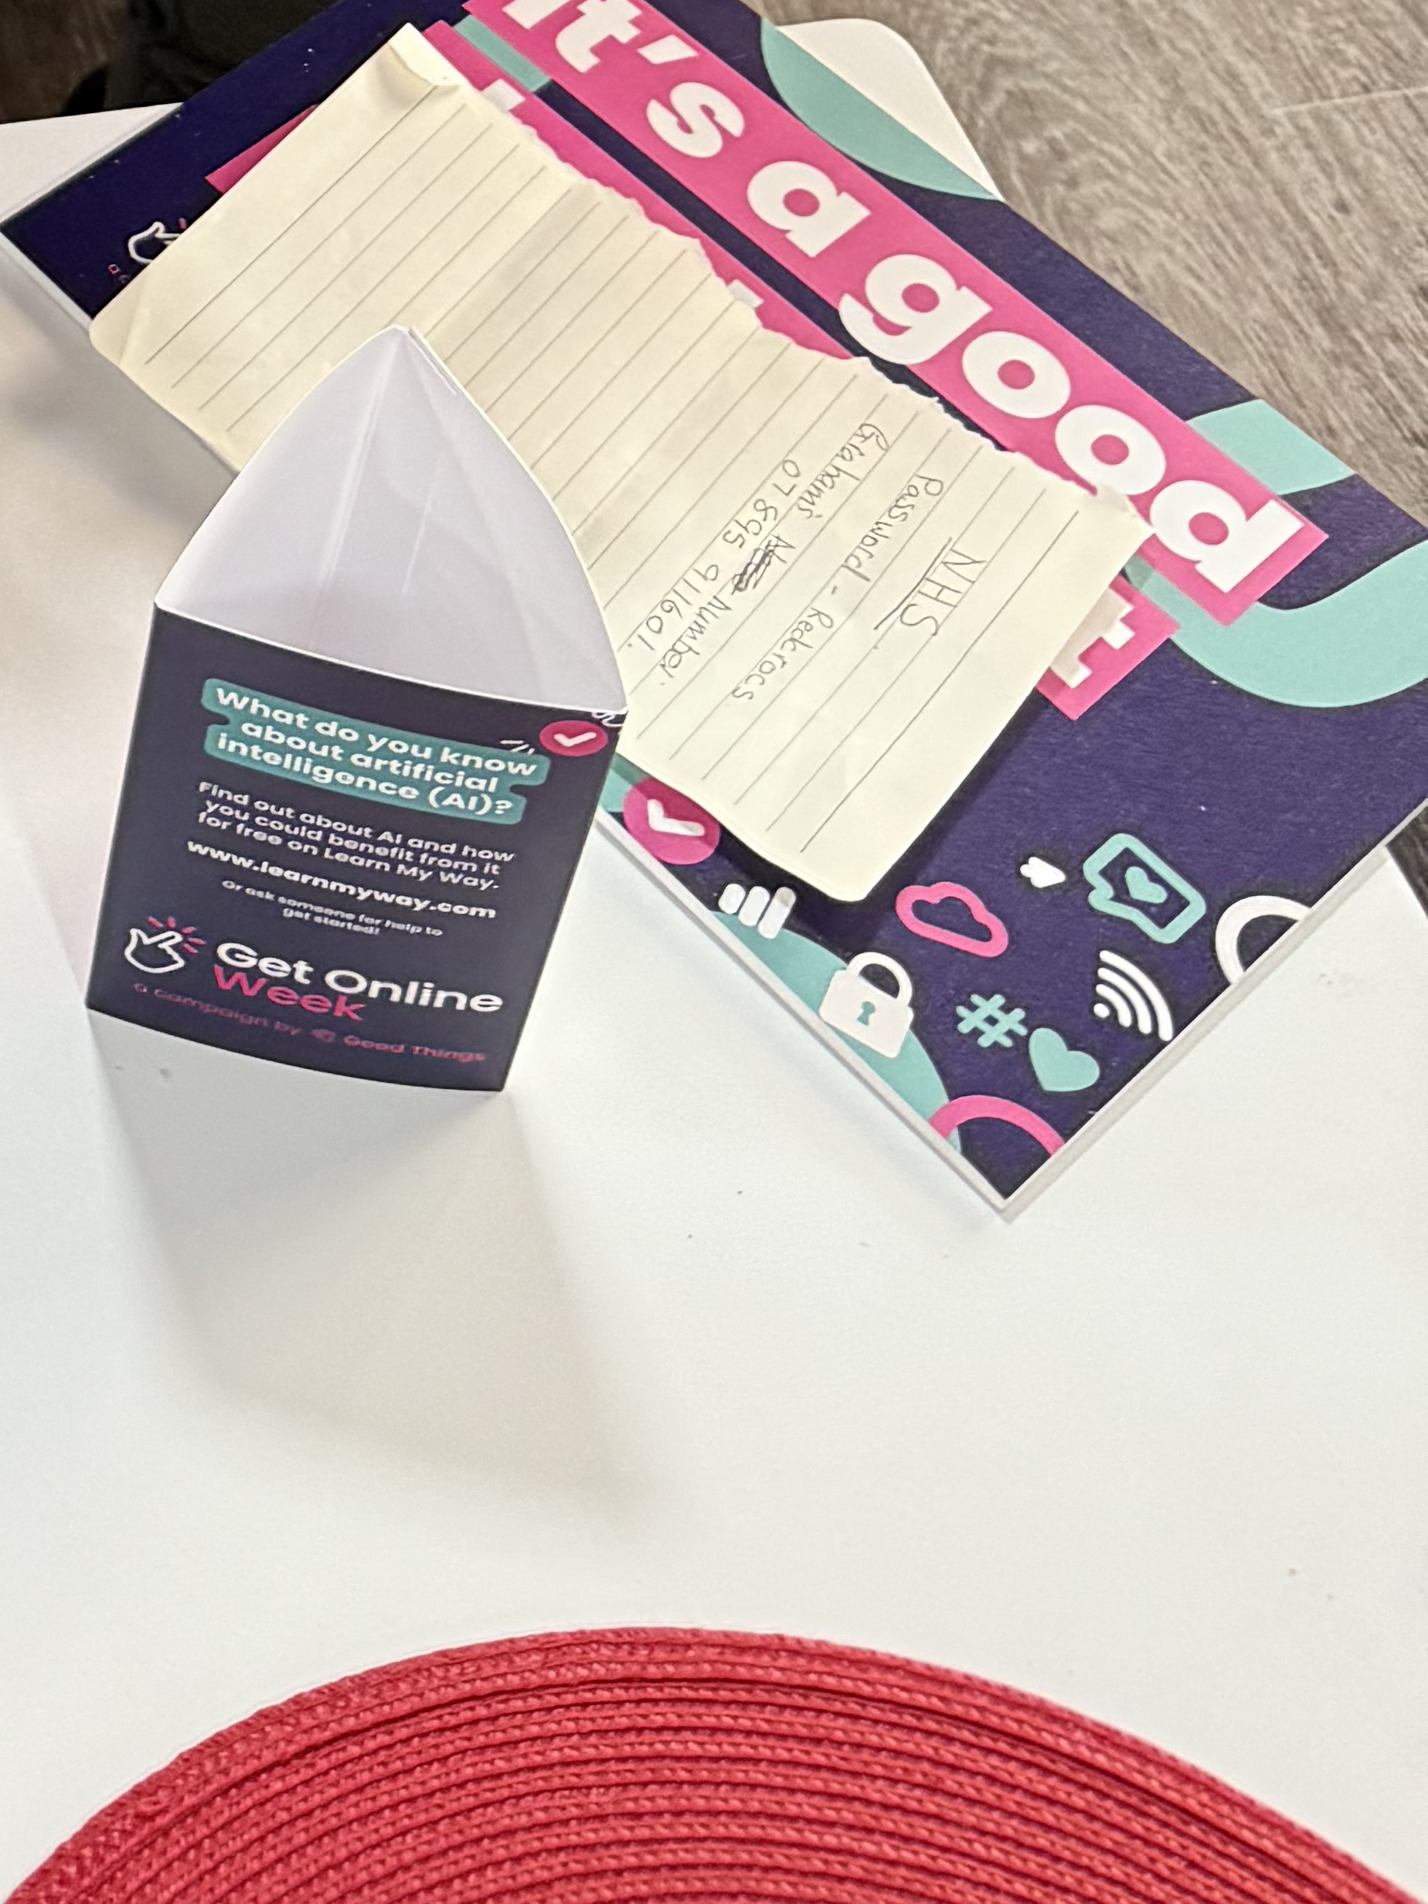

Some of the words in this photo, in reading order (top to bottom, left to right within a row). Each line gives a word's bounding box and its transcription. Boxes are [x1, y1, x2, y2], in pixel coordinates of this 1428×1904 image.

[746, 160, 870, 259] a
[838, 253, 1305, 593] good
[842, 473, 945, 583] Password
[898, 548, 988, 637] NHS
[216, 687, 309, 730] What
[314, 721, 359, 742] do
[367, 733, 433, 760] you
[440, 747, 538, 776] know
[241, 722, 344, 762] about
[350, 753, 499, 793] artificial
[218, 732, 419, 800] intelligence
[428, 786, 514, 816] (AI)?
[198, 781, 250, 806] Find
[254, 800, 296, 819] out
[299, 813, 374, 839] about
[377, 831, 403, 844] AI
[407, 838, 457, 855] and
[462, 845, 515, 862] how
[198, 811, 232, 830] for
[236, 823, 283, 846] free
[287, 840, 318, 856] on
[323, 847, 391, 872] Learn
[396, 863, 434, 882] My
[439, 870, 500, 891] Way.
[205, 800, 250, 821] you
[255, 816, 323, 842] could
[328, 833, 414, 862] benefit
[419, 852, 478, 873] from
[483, 862, 501, 875] it
[187, 841, 497, 919] www.learnmyway.com
[222, 880, 243, 891] Or
[245, 887, 275, 901] ask
[277, 896, 356, 921] someone
[358, 914, 382, 925] for
[384, 920, 423, 934] help
[425, 927, 443, 936] to
[282, 907, 312, 921] get
[213, 963, 367, 1022] Week
[216, 942, 314, 985] Get
[324, 969, 504, 1013] Online
[344, 1034, 405, 1054] Good
[411, 1045, 486, 1063] Things
